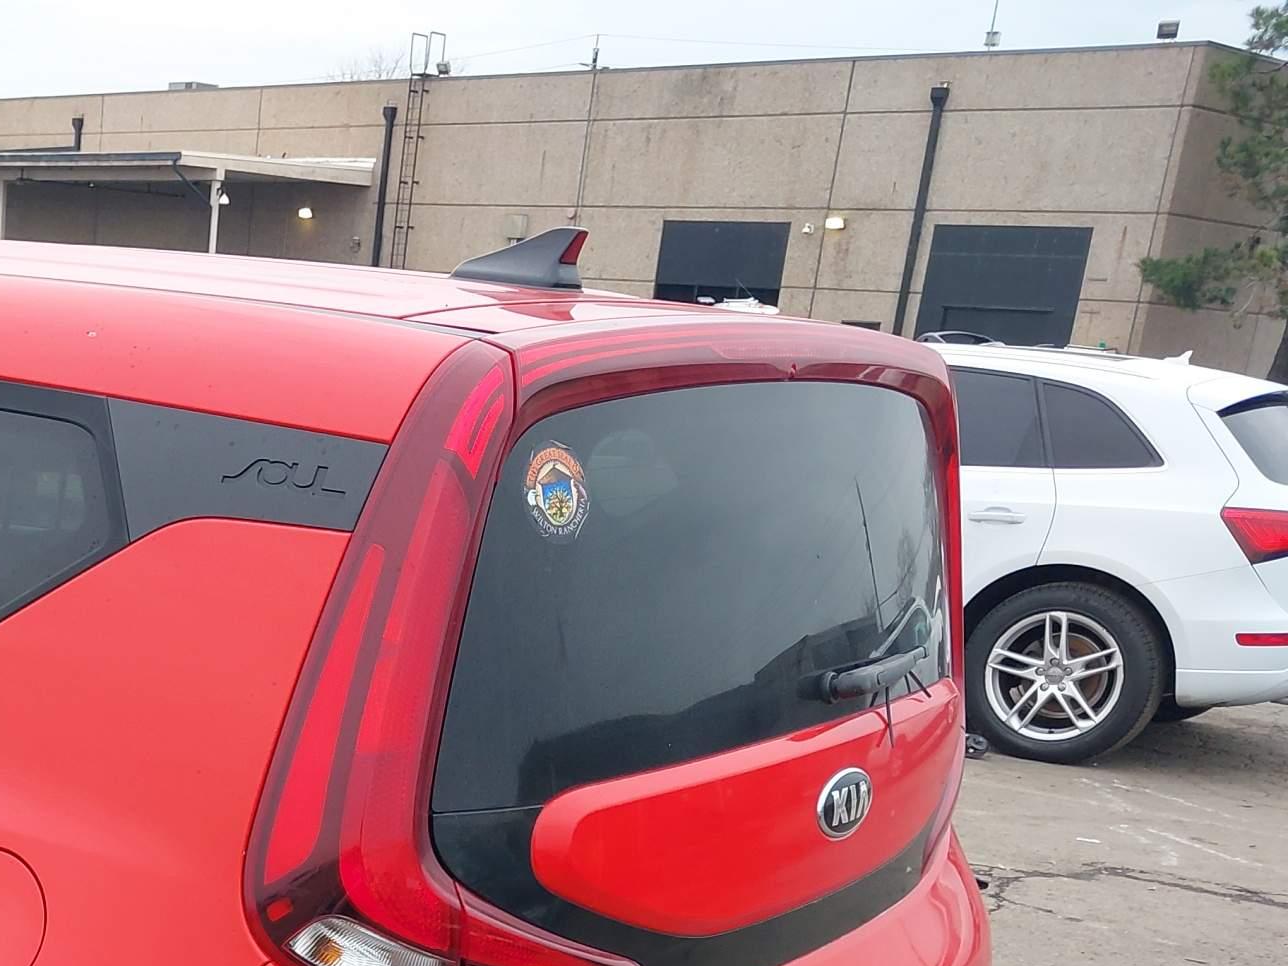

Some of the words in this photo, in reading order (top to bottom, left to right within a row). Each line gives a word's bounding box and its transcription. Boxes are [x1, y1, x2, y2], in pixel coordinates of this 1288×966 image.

[221, 458, 346, 495] SOUL
[532, 506, 558, 535] WILTON
[558, 498, 585, 535] RANCHERIA
[831, 780, 869, 827] KIA
